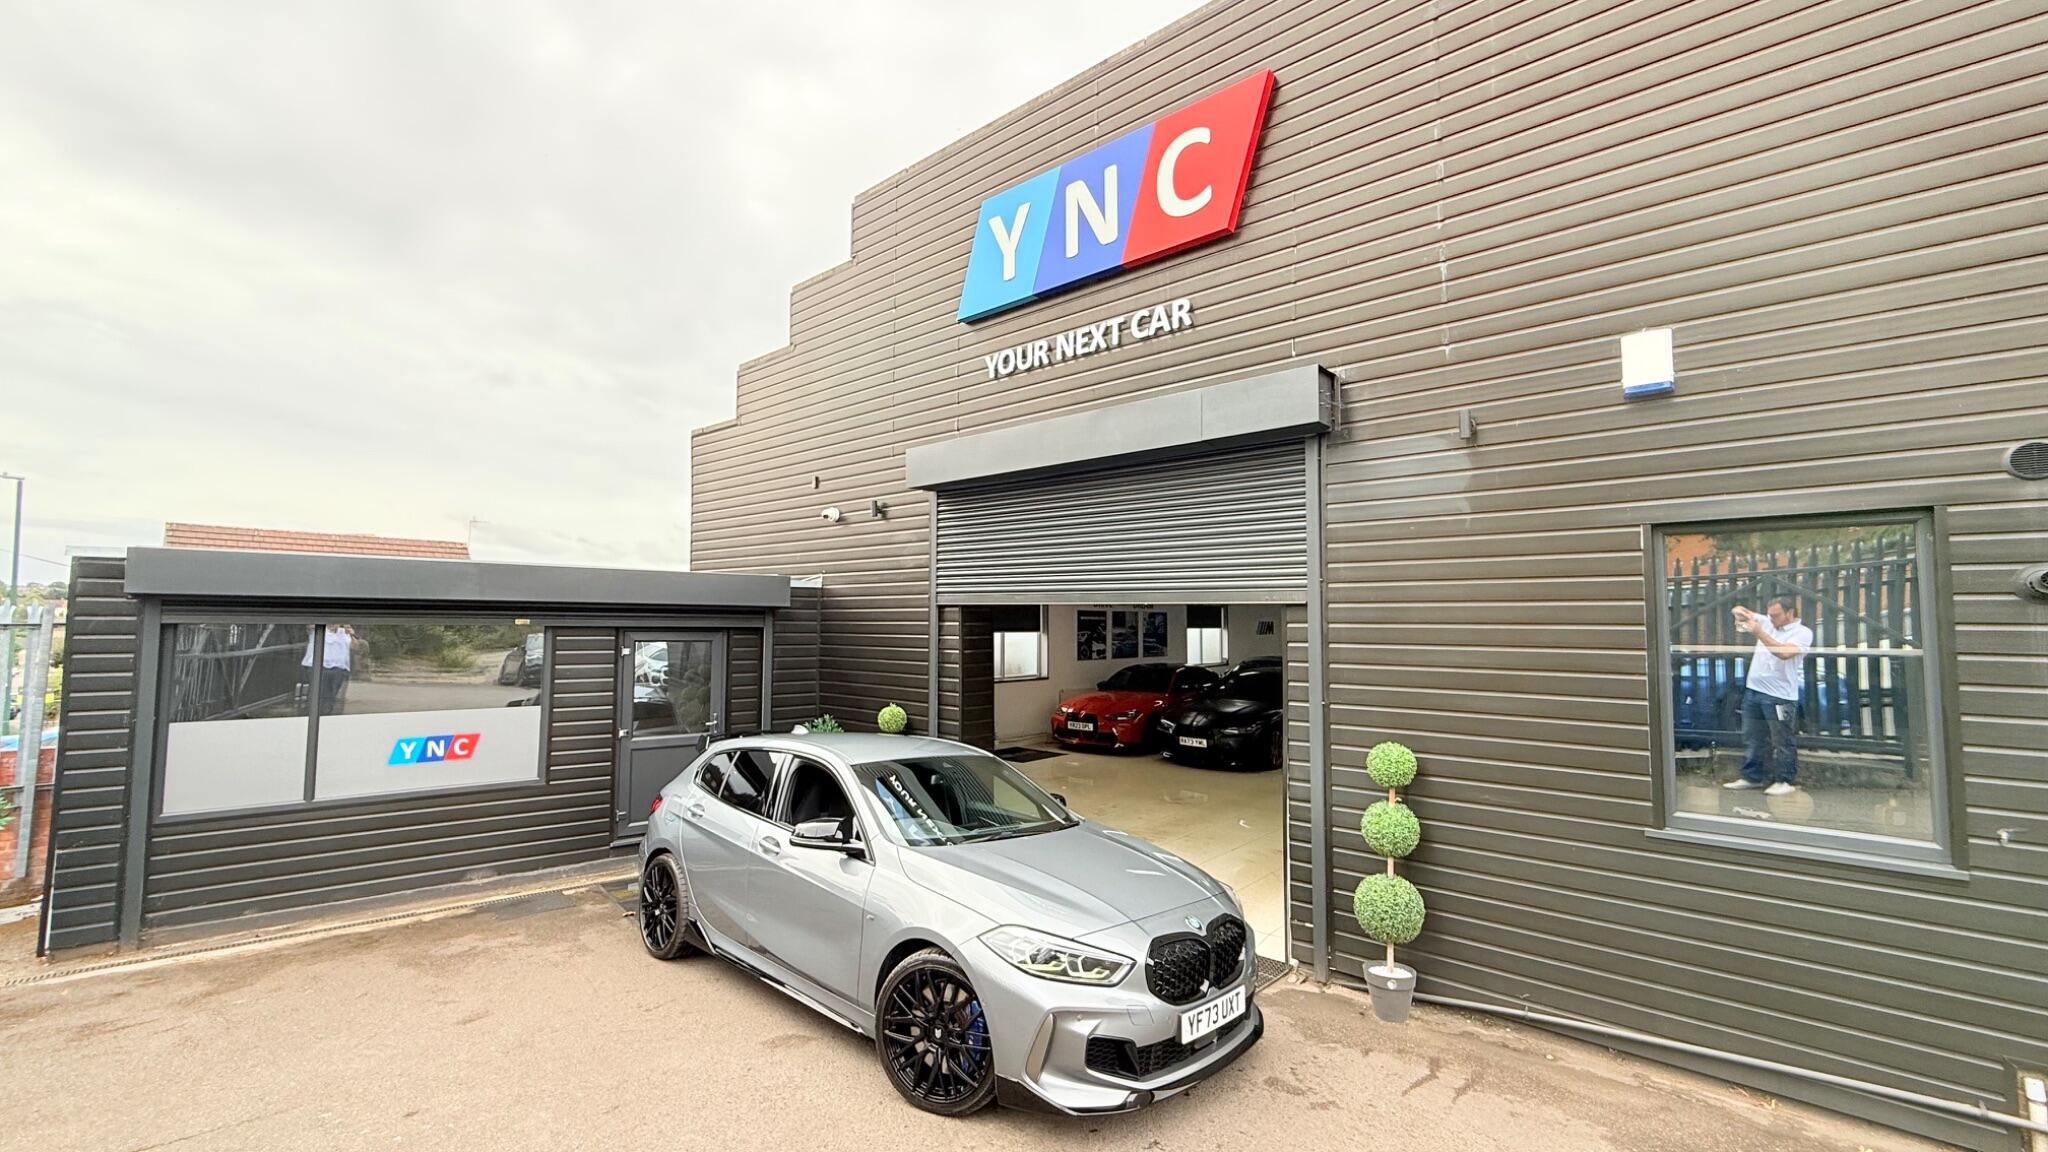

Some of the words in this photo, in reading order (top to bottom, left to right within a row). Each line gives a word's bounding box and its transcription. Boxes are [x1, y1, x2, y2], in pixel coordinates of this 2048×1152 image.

[988, 126, 1213, 281] YNC
[984, 339, 1049, 379] YOUR
[1055, 316, 1126, 361] NEXT
[1130, 298, 1193, 340] CAR
[400, 738, 469, 759] YNC
[1188, 1003, 1219, 1035] YF73
[1222, 991, 1240, 1019] UXT
